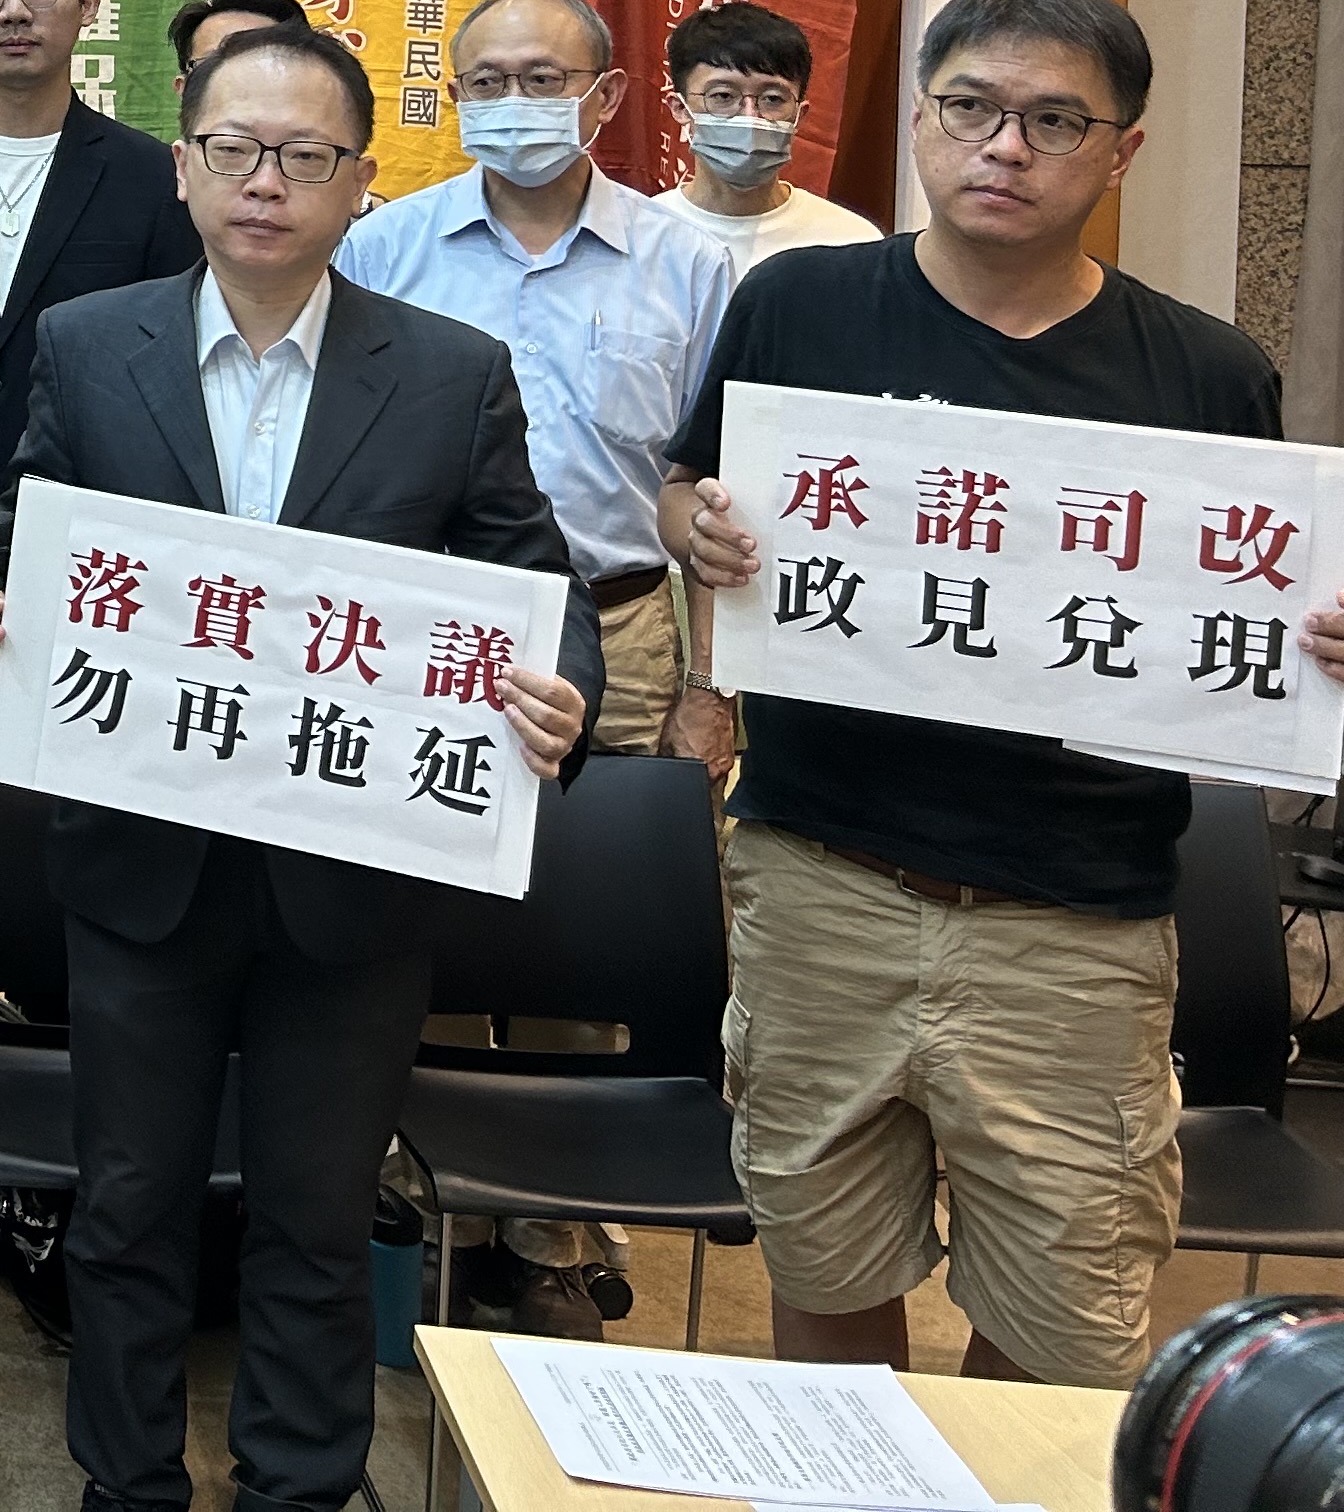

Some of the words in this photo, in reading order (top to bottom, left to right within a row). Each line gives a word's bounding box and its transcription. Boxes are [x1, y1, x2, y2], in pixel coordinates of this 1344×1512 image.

[778, 453, 1301, 592] 承諾司改
[67, 546, 516, 713] 落實決議
[773, 556, 1289, 700] 政見兌現
[50, 646, 498, 816] 勿再拖延
